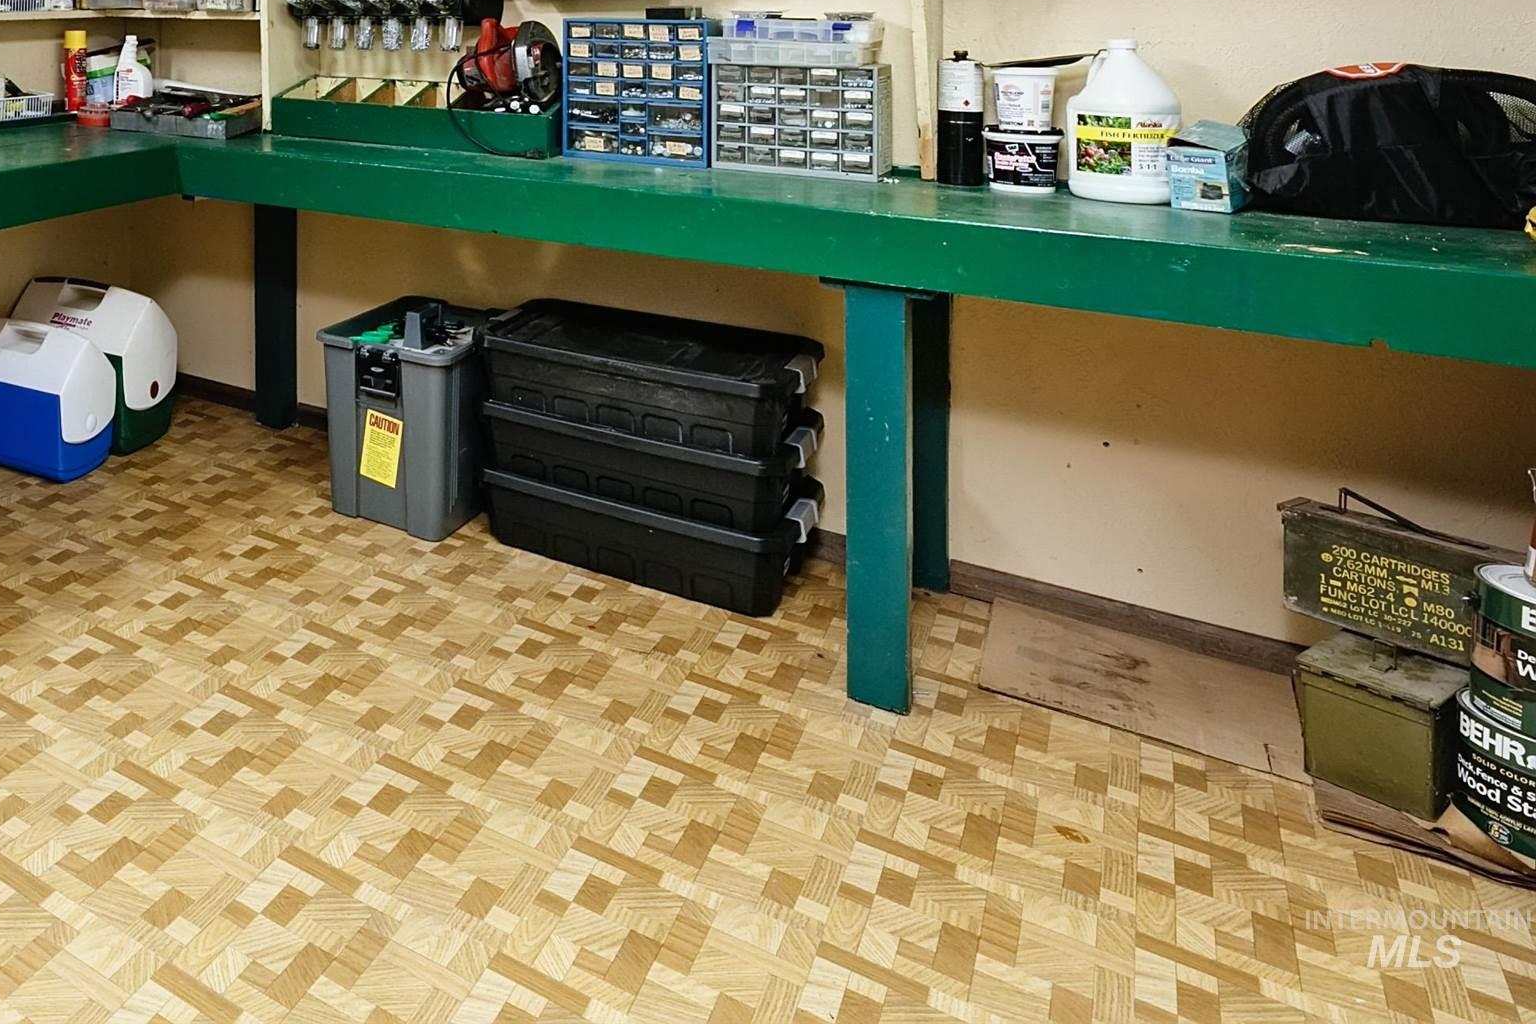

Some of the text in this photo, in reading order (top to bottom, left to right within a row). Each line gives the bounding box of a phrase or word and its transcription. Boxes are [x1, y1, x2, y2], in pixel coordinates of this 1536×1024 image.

[1100, 130, 1120, 139] FISH
[1171, 164, 1206, 176] Bomba
[52, 312, 93, 326] Playmate
[369, 413, 400, 436] CAUTION
[1331, 544, 1451, 585] 200 CARTRIDGES
[1319, 584, 1357, 603] FUNC
[1361, 597, 1388, 611] LOT
[1423, 601, 1455, 619] M80
[1429, 633, 1465, 652] A131
[1459, 710, 1526, 768] BEHR
[1471, 752, 1536, 788] SOLID COLOR
[1457, 762, 1501, 805] Wood
